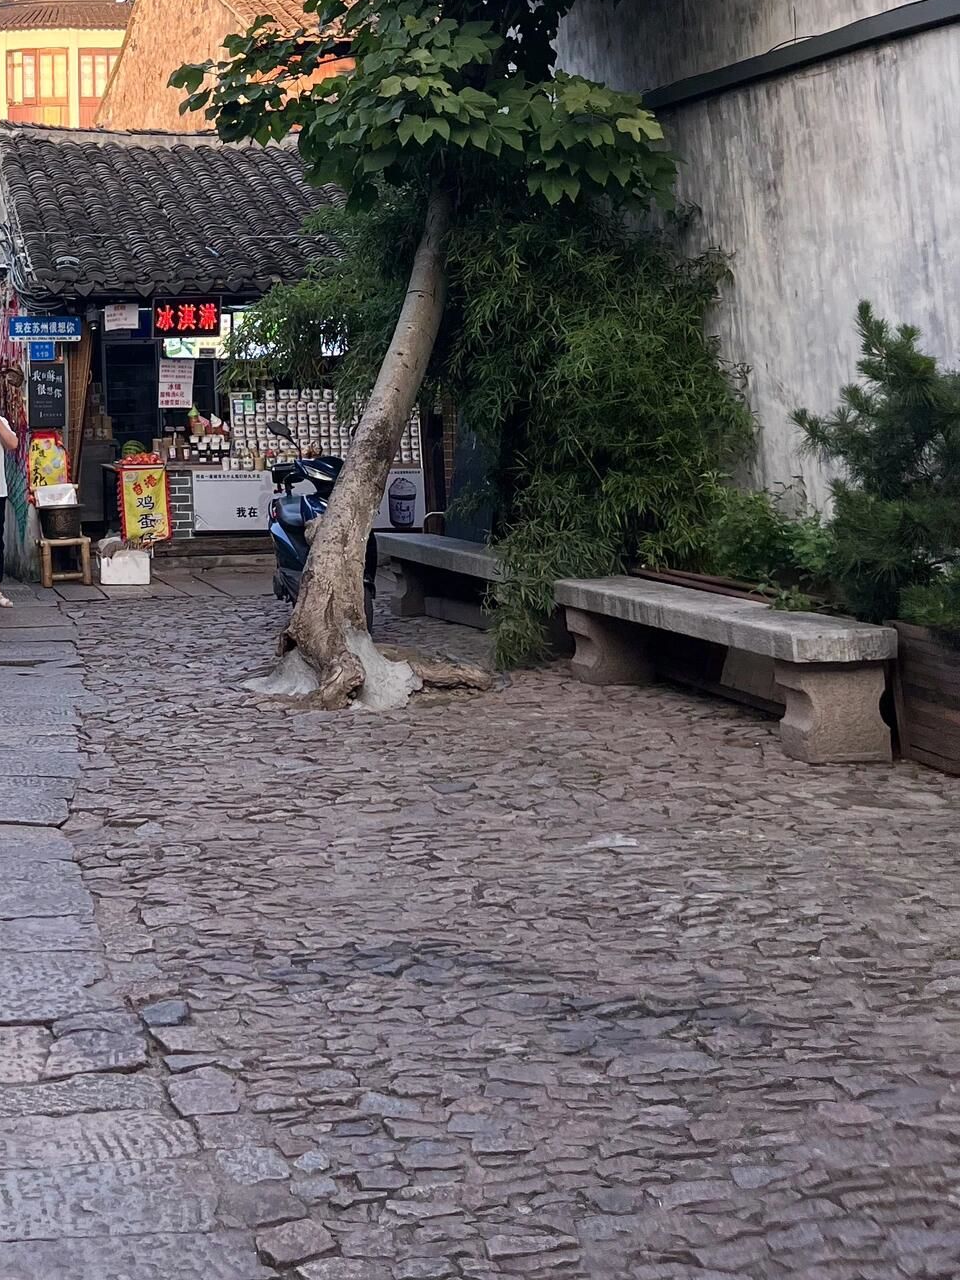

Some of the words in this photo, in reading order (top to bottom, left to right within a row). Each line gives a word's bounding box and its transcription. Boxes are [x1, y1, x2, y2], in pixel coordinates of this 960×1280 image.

[156, 304, 217, 331] 冰淇淋
[15, 322, 75, 334] 我在苏州很想你
[136, 494, 157, 543] 鸡蛋仔
[236, 506, 258, 518] 我在
